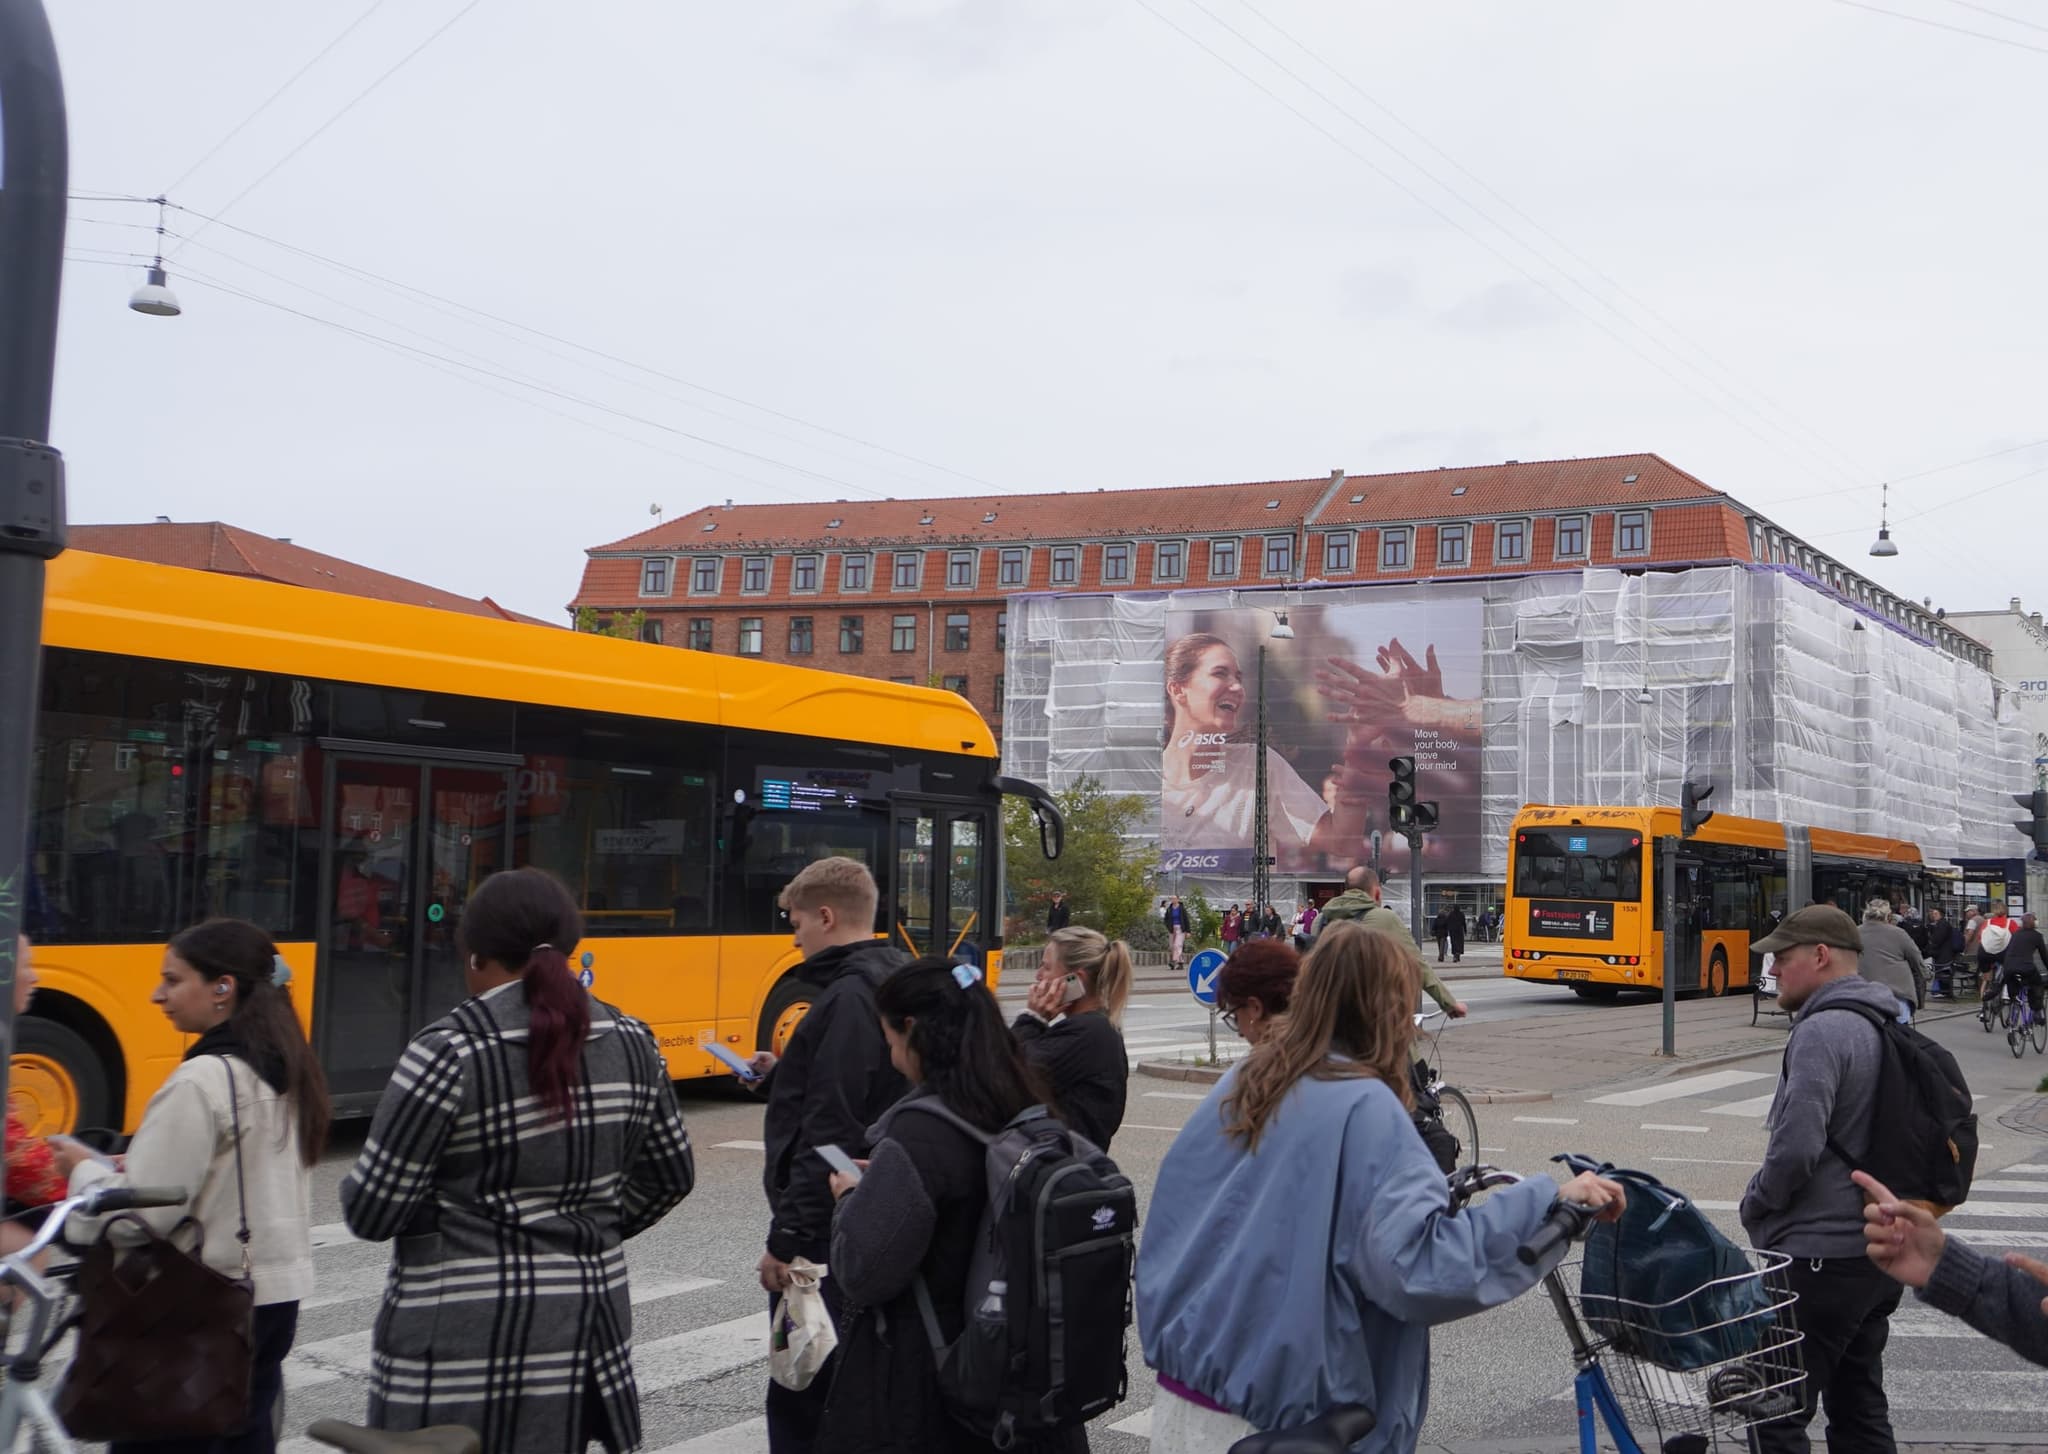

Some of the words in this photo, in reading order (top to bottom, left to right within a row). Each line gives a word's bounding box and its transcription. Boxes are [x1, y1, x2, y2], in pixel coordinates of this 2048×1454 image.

[1414, 729, 1438, 738] Move
[1414, 741, 1434, 751] your
[1436, 739, 1459, 751] body,
[1414, 752, 1438, 760] move
[1414, 762, 1434, 772] your
[1436, 760, 1457, 770] mind
